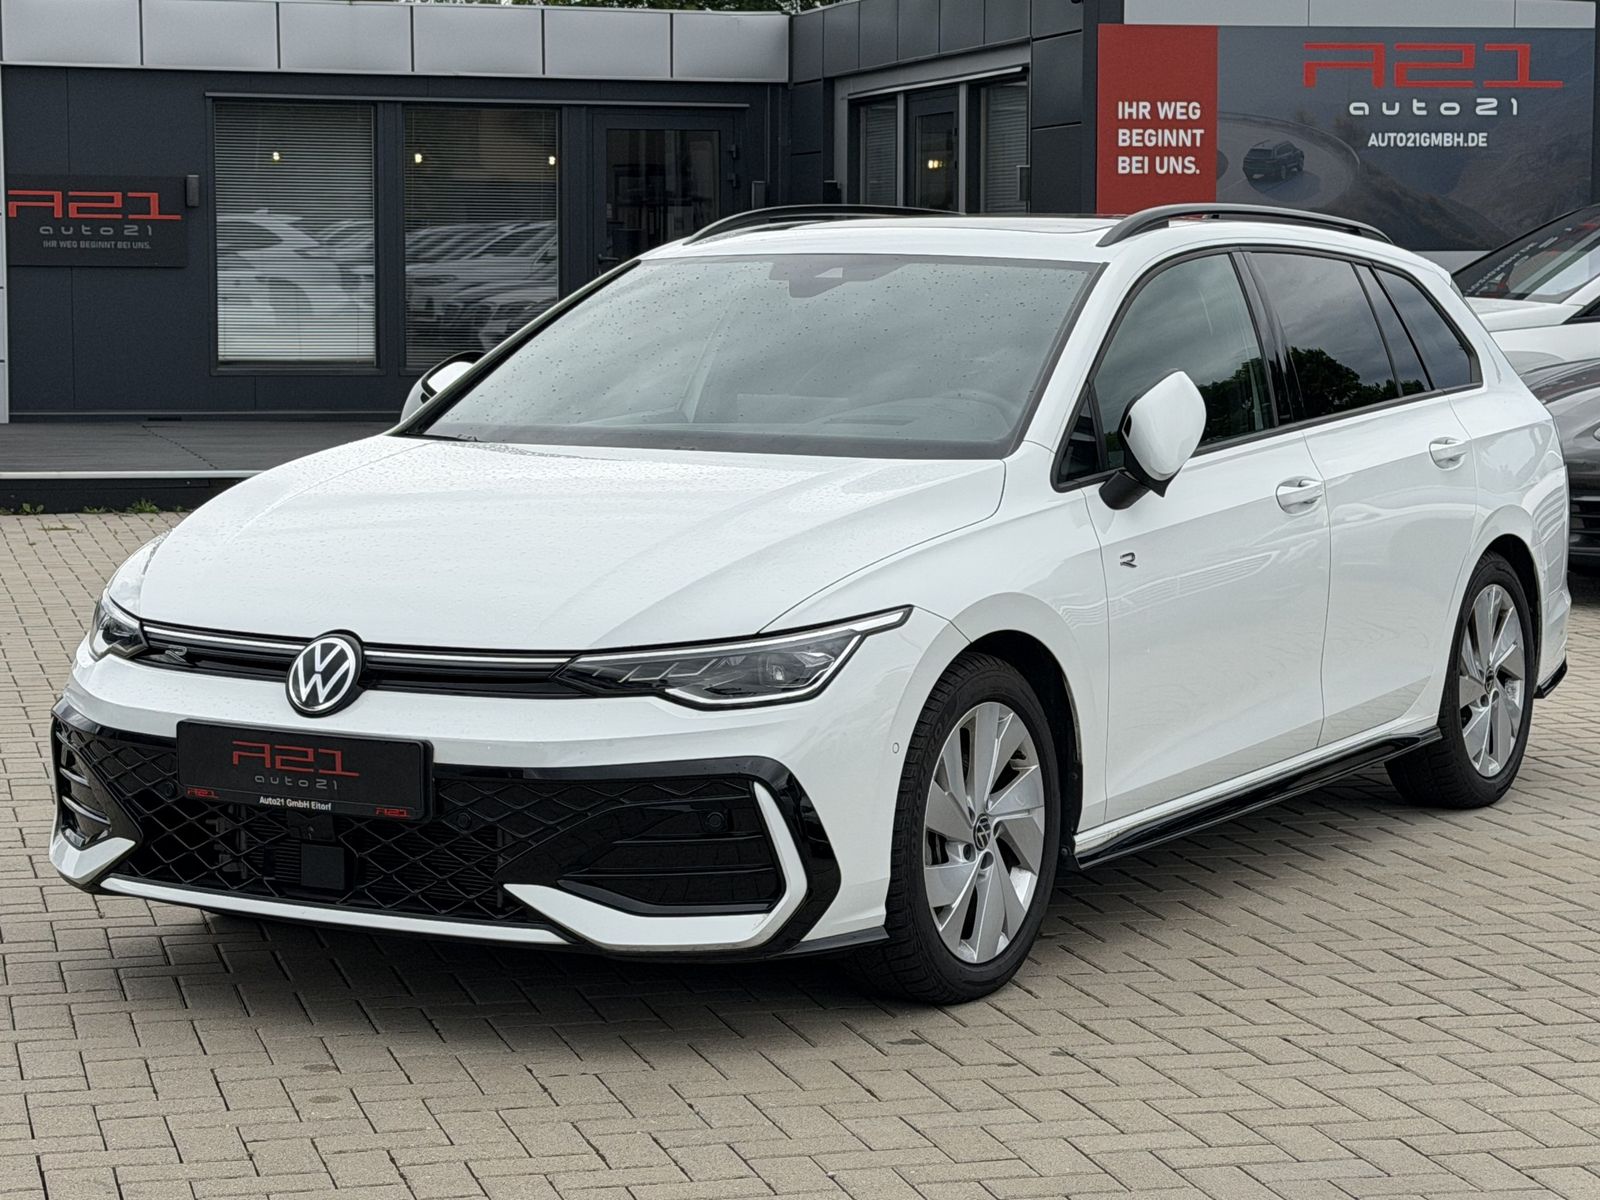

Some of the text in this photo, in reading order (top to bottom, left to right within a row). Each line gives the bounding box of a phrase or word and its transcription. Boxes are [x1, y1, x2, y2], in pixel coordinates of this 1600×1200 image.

[1303, 41, 1564, 88] A21
[1117, 101, 1201, 119] IHR WEG
[1117, 128, 1205, 147] BEGINNT
[1367, 132, 1488, 148] AUTO21GMBH.DE
[1117, 156, 1201, 175] BEI UNS.
[8, 190, 182, 220] A21
[43, 240, 57, 249] IHR
[59, 240, 78, 249] WEG
[80, 240, 115, 249] BEGINNT
[117, 241, 130, 249] BEI
[259, 795, 332, 811] Auto21 GmbH Eitorf
